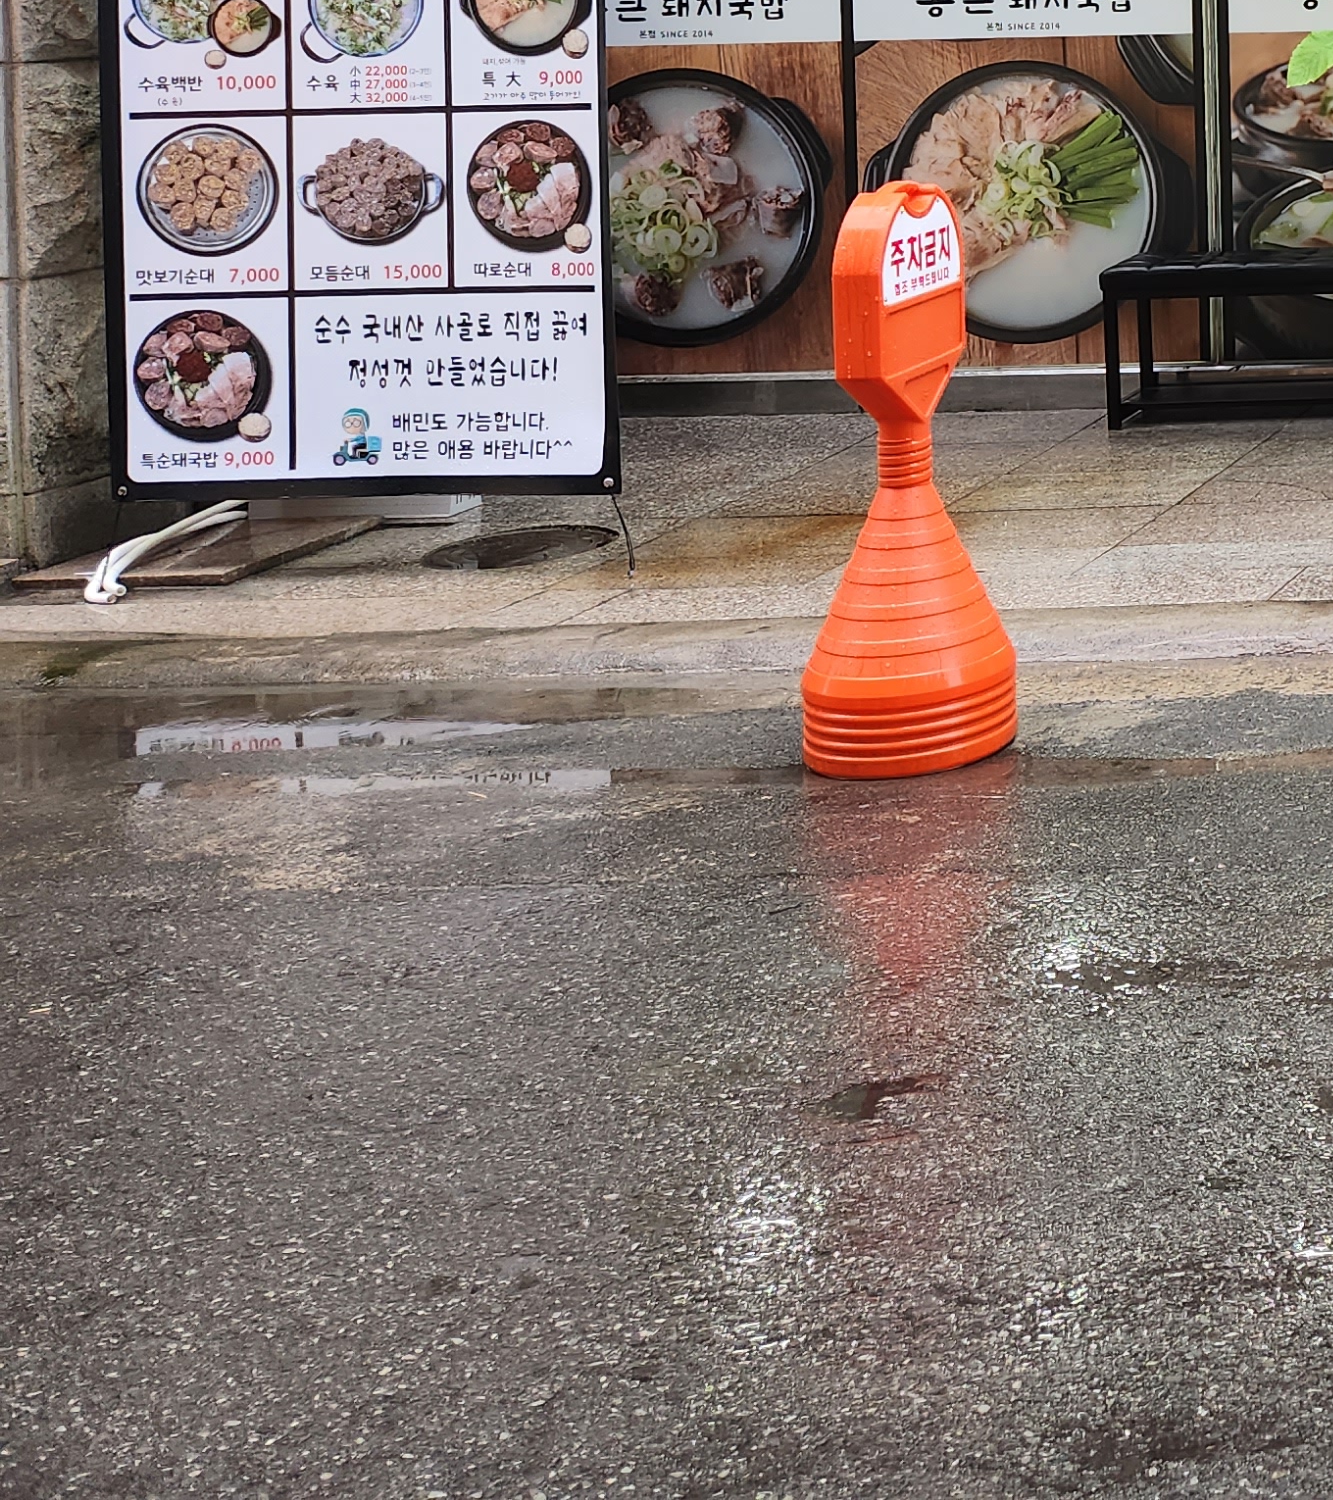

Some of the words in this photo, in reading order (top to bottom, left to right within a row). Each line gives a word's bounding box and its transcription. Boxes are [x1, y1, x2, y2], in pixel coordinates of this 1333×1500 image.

[660, 30, 689, 39] SINCE
[693, 30, 713, 38] 2014
[1008, 22, 1037, 31] SINCE
[1040, 22, 1061, 30] 2014
[365, 65, 408, 77] 22,000
[482, 71, 496, 87] 특
[506, 71, 521, 87] 大
[539, 70, 582, 87] 9,000
[138, 76, 203, 91] 수육백반
[217, 75, 276, 91] 10,000
[306, 76, 339, 91] 수육
[365, 79, 408, 91] 27,000
[365, 92, 408, 104] 32,000
[890, 224, 951, 277] 주차금지
[135, 269, 215, 286] 맛보기순대
[229, 268, 280, 285] 7,000
[310, 265, 371, 281] 모듬순대
[383, 264, 442, 281] 15,000
[473, 262, 532, 279] 따로순대
[551, 261, 595, 278] 8,000
[314, 315, 352, 344] 순수
[362, 314, 425, 343] 국내산
[435, 312, 493, 339] 사골로
[503, 311, 542, 342] 직접
[551, 310, 588, 342] 끓여
[348, 359, 414, 389] 정성껏
[425, 355, 558, 387] 만들었습니다!
[392, 414, 448, 431] 배민도
[456, 411, 549, 431] 가능합니다.
[392, 440, 429, 460] 많은
[438, 440, 475, 458] 애용
[140, 452, 219, 470] 특순돼국밥
[223, 450, 274, 468] 9,000
